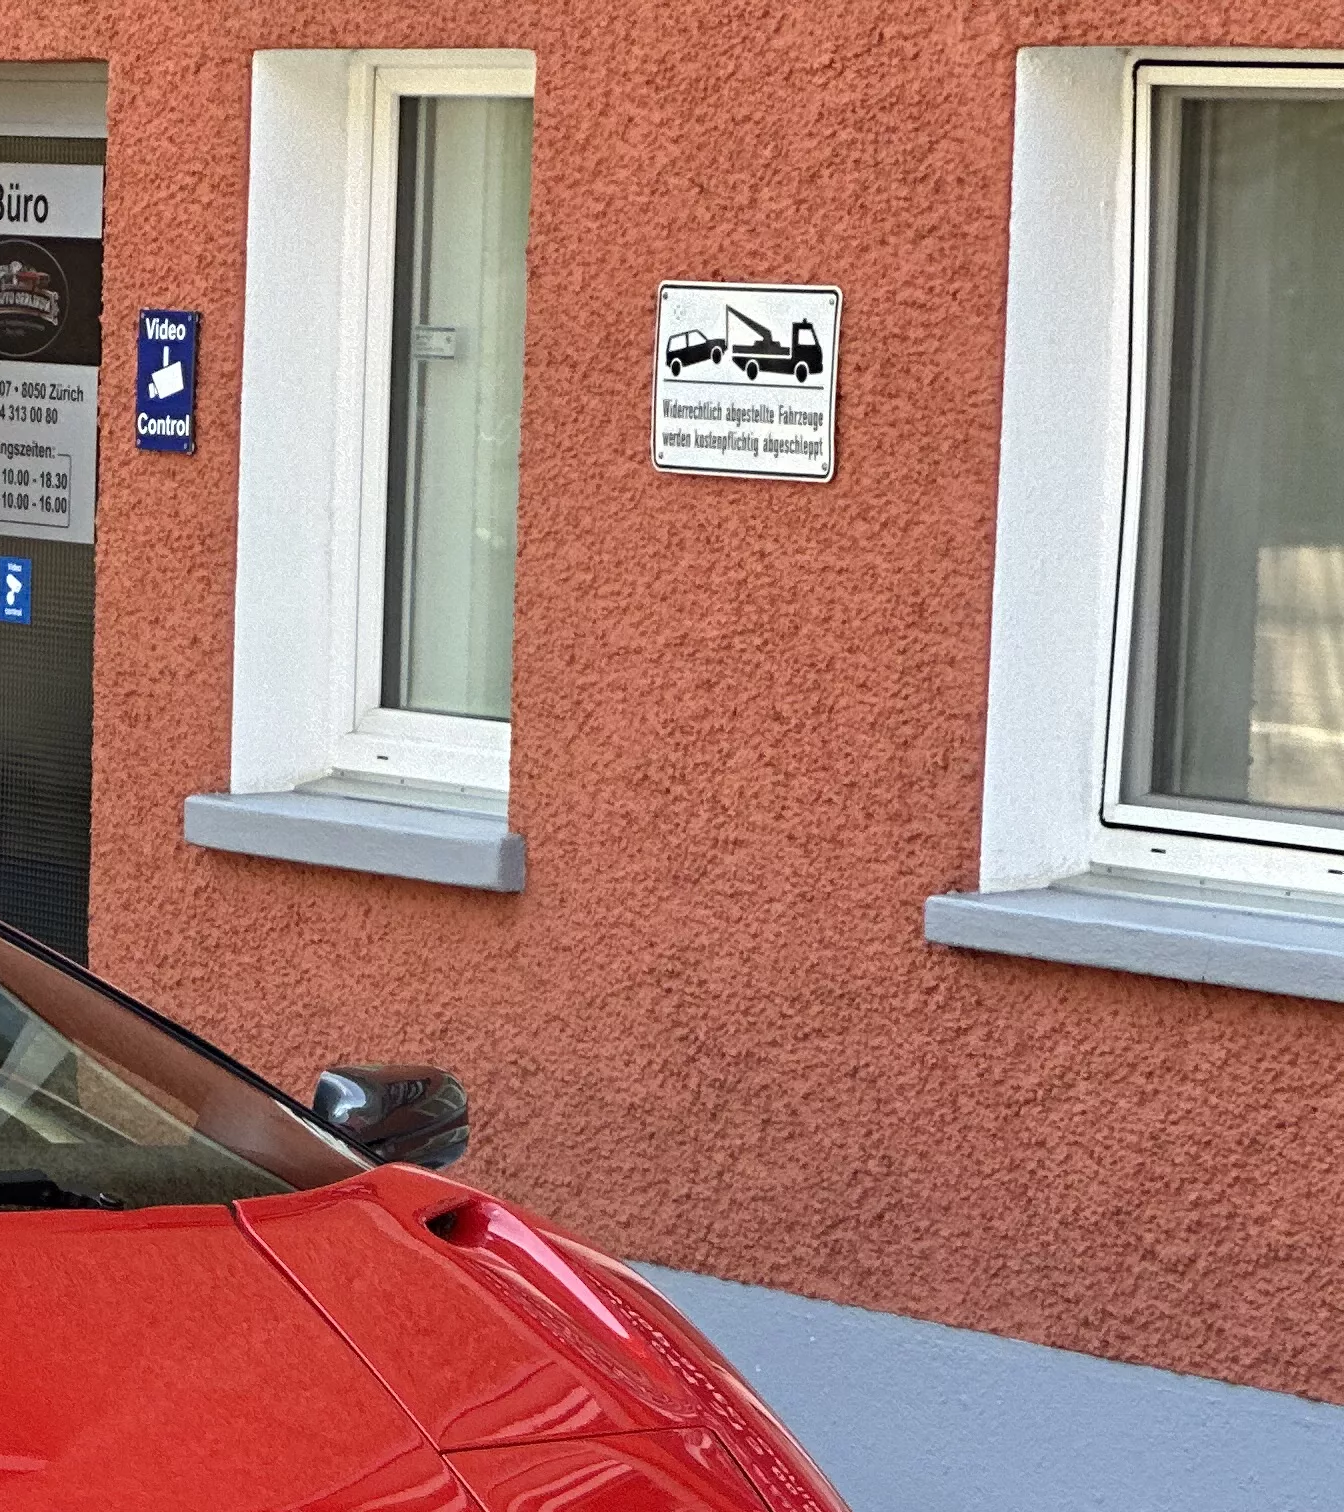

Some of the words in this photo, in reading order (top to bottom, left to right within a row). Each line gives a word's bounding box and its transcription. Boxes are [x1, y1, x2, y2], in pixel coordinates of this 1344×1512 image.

[145, 317, 186, 341] Video
[21, 381, 46, 400] 8050
[49, 383, 84, 402] Zürich
[8, 405, 27, 422] 313
[30, 406, 43, 423] 00
[45, 407, 58, 424] 80
[137, 412, 190, 437] Control
[662, 399, 722, 421] Widerrechtlich
[725, 402, 774, 427] abgestellte
[778, 404, 824, 431] Fahrzeuge
[662, 428, 691, 448] werden
[694, 429, 759, 457] kostenpflichtig
[763, 434, 823, 461] abgeschleppt
[2, 468, 29, 486] 10.00
[40, 471, 68, 490] 18.30
[2, 492, 29, 510] 10.00
[39, 495, 67, 514] 16.00
